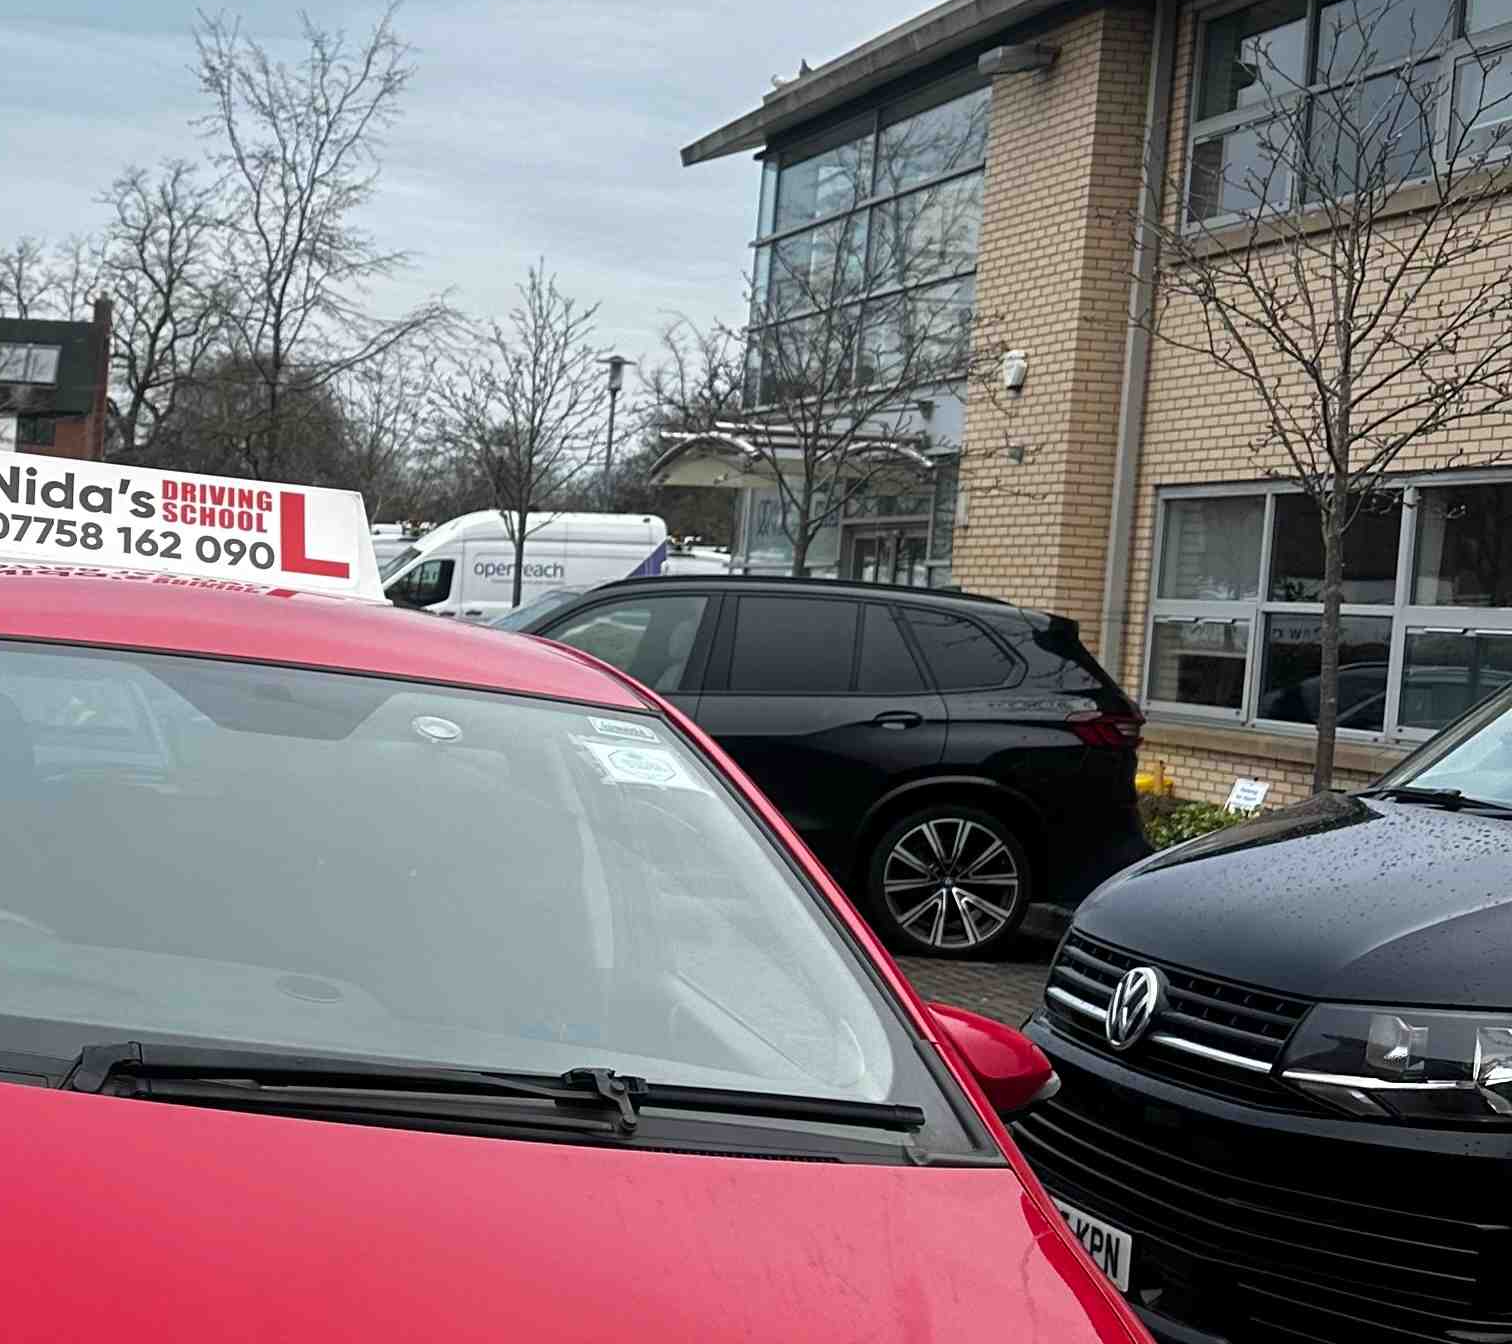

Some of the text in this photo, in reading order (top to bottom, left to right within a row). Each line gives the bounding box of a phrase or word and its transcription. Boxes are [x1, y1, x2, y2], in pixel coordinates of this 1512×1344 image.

[162, 479, 273, 513] DRIVING
[162, 502, 268, 533] SCHOOL
[116, 526, 182, 560] 162
[195, 535, 275, 571] 090
[279, 490, 350, 580] L
[473, 561, 565, 579] openeach
